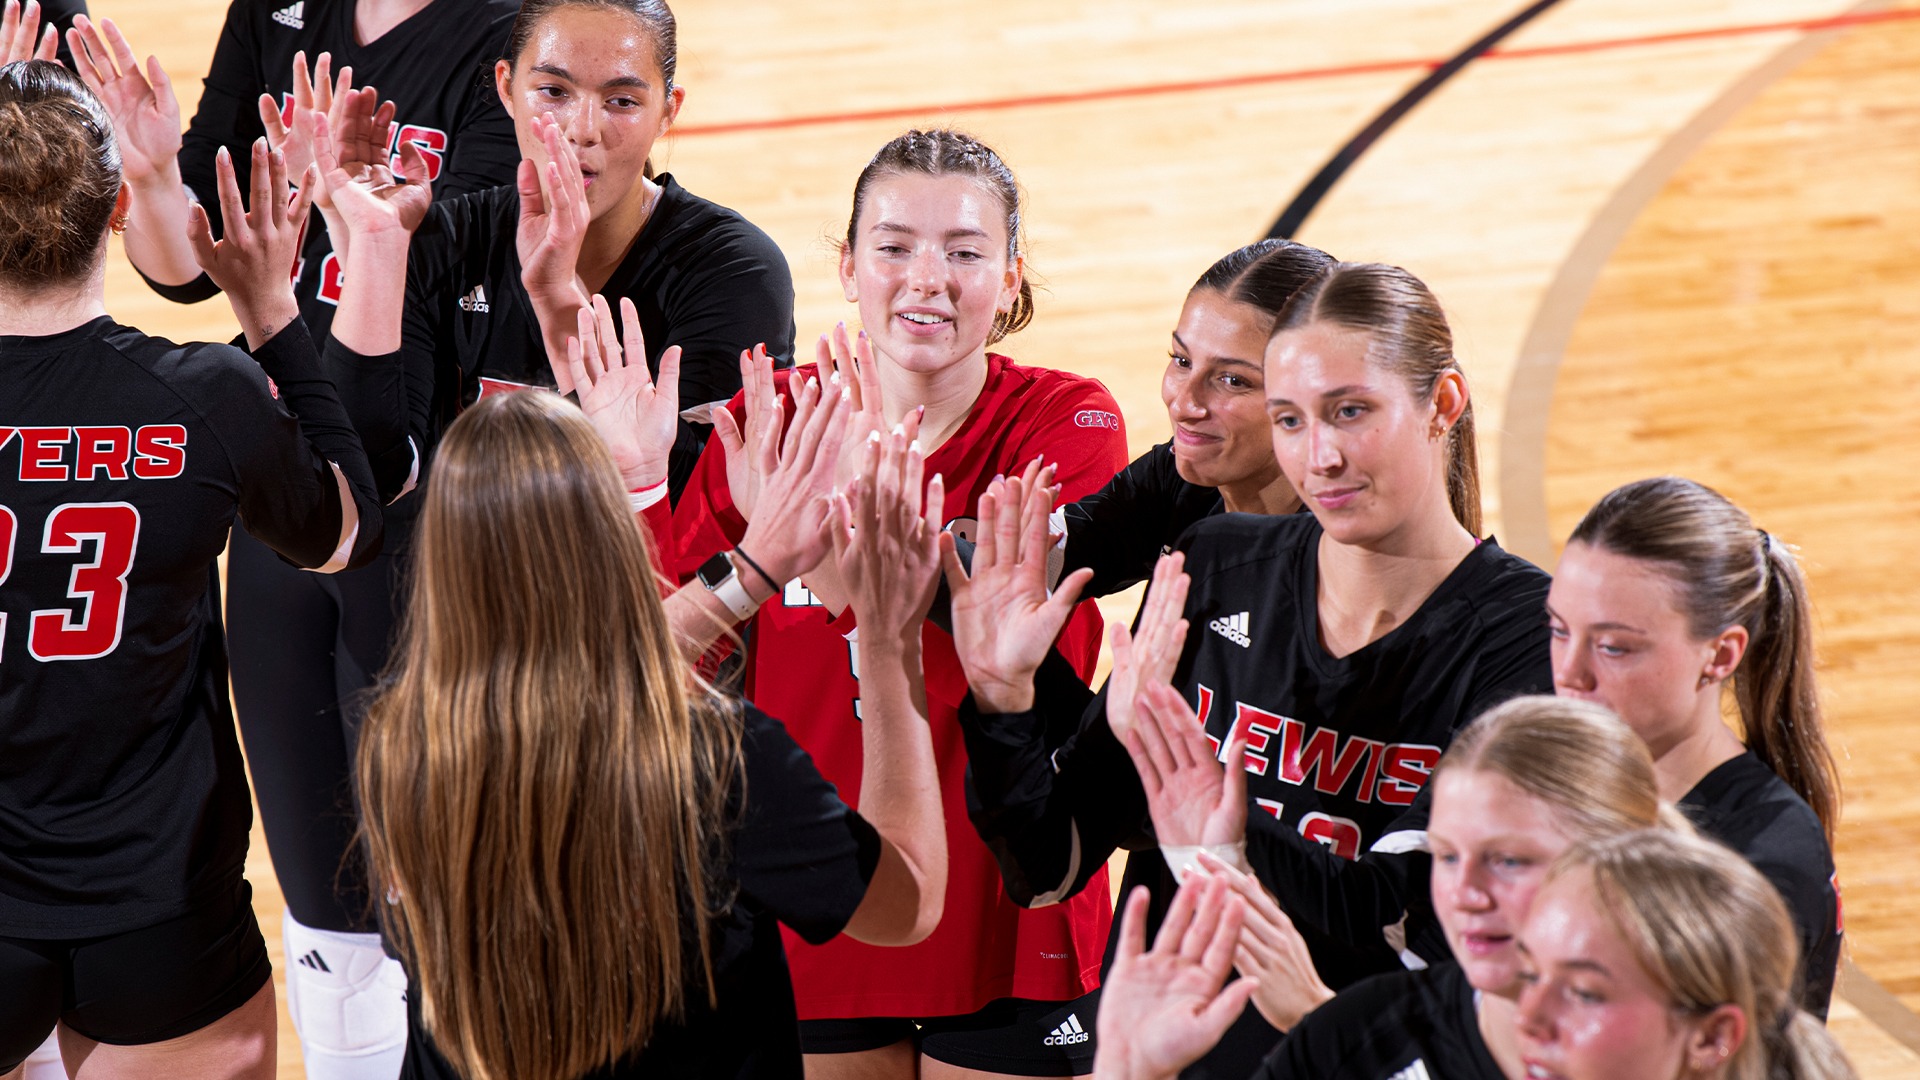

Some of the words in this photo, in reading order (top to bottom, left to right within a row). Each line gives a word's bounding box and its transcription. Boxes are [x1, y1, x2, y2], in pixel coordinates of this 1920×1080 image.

[459, 297, 489, 313] adidas
[0, 424, 187, 481] ERS
[0, 501, 141, 662] 3
[1210, 620, 1251, 648] adidas
[1043, 1032, 1089, 1046] adidas
